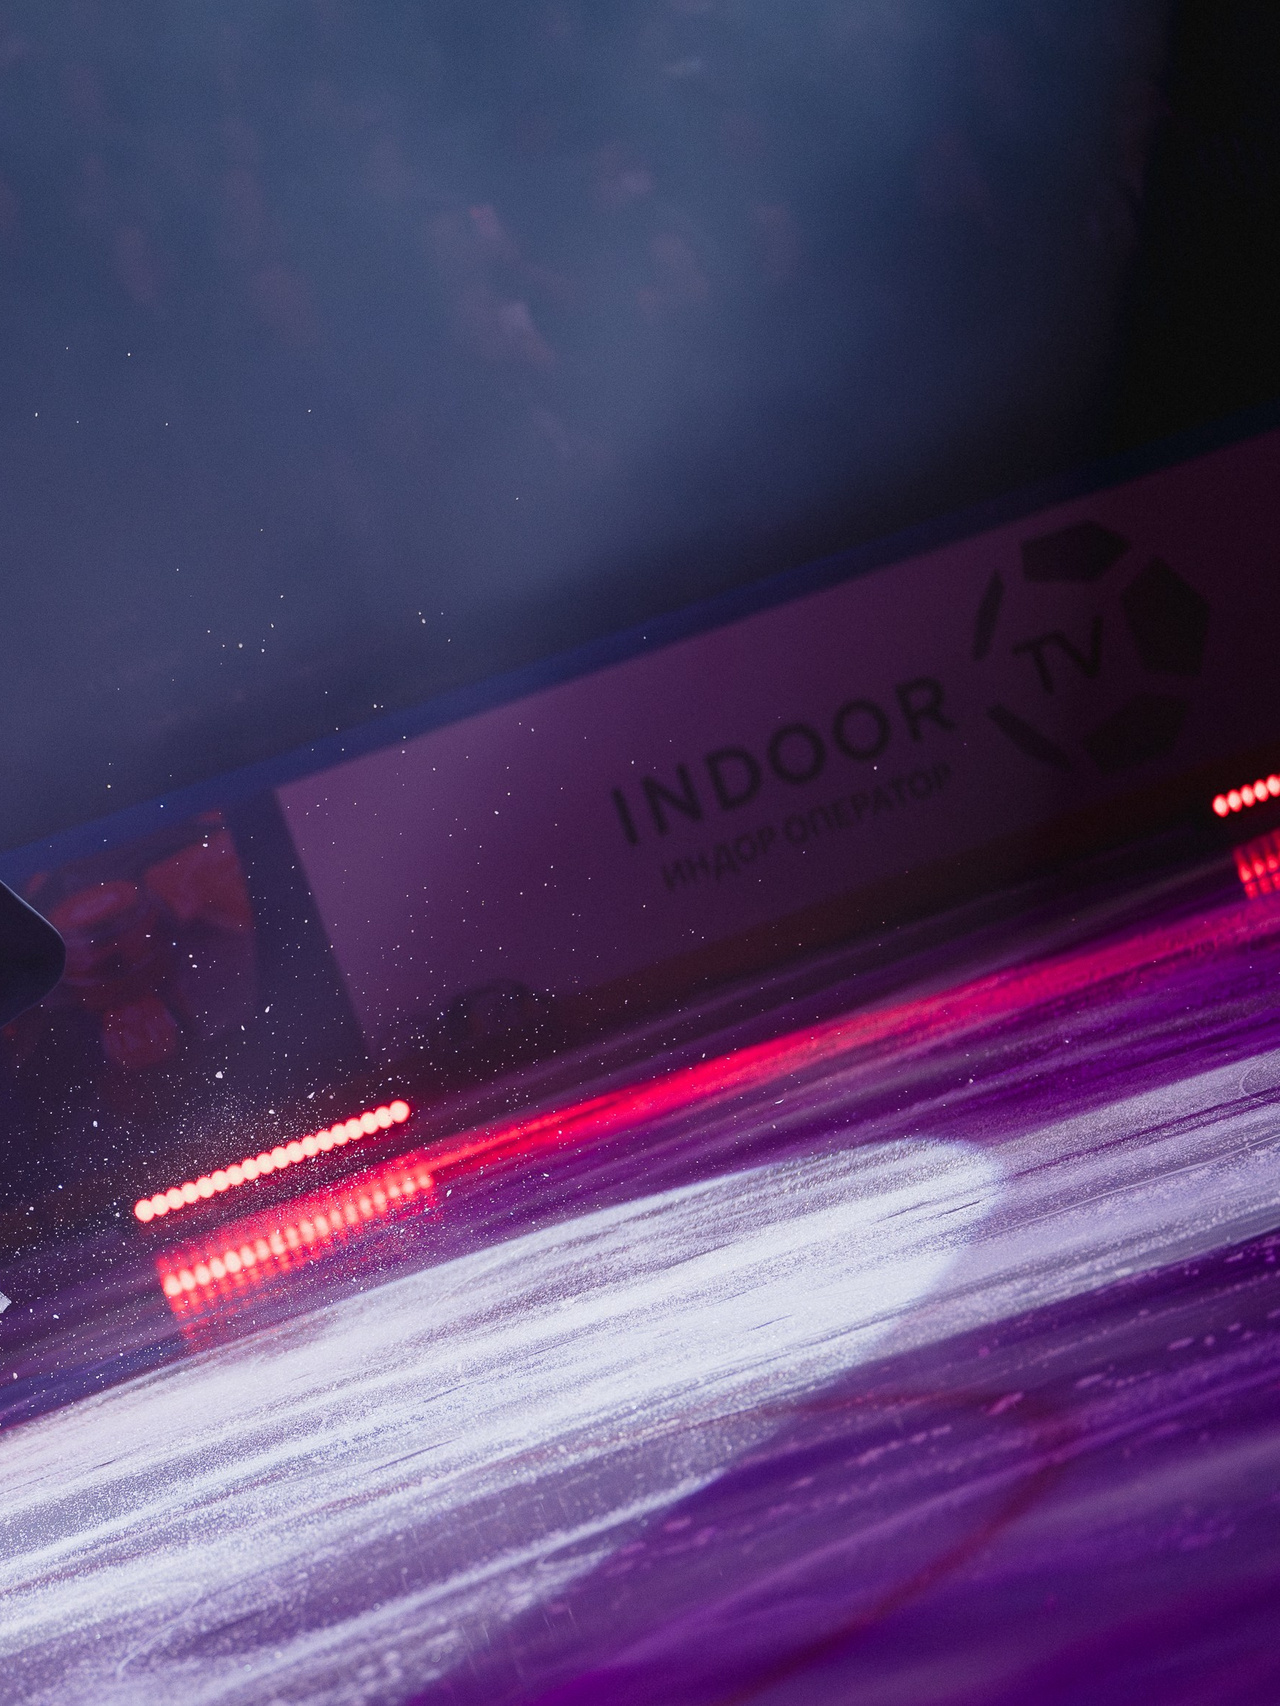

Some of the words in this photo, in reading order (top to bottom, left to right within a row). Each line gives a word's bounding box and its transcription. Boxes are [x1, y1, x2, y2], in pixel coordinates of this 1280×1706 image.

[1014, 615, 1105, 694] TV
[611, 676, 959, 845] INDOOR
[783, 761, 953, 844] ОПЕРАТОР
